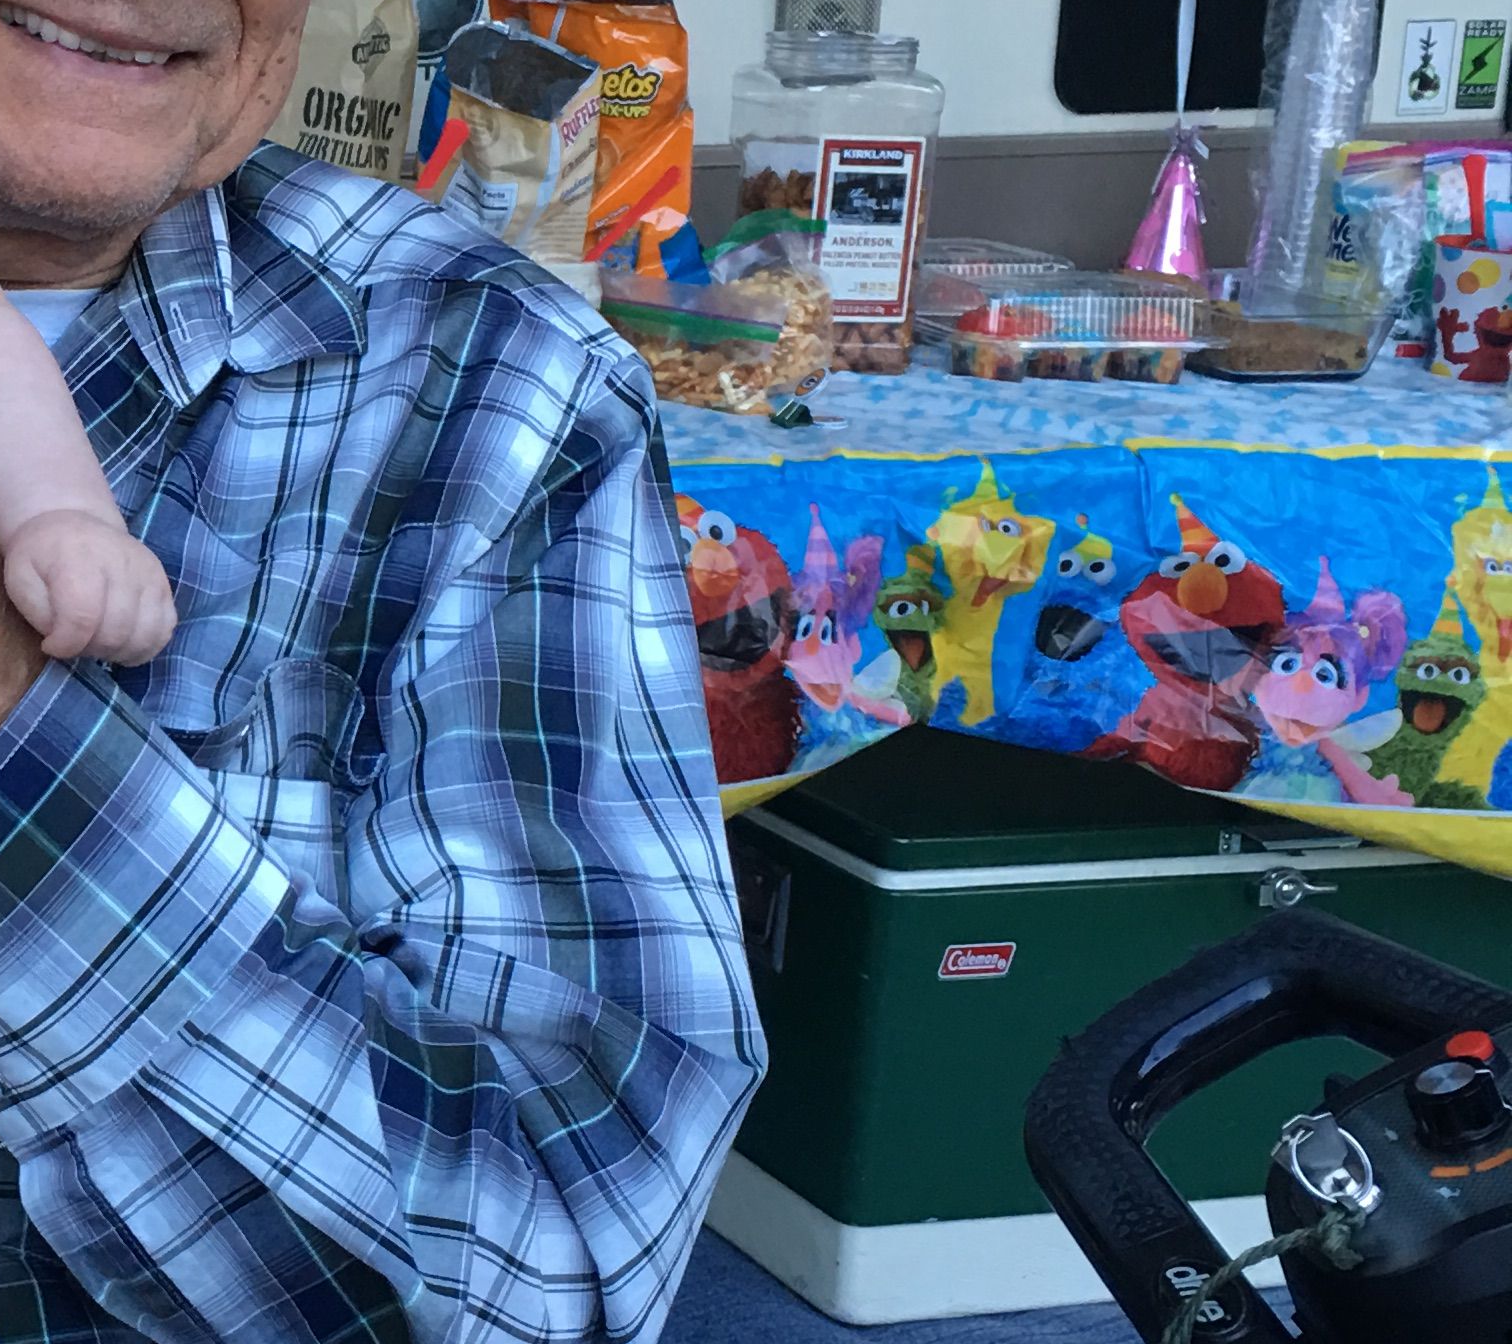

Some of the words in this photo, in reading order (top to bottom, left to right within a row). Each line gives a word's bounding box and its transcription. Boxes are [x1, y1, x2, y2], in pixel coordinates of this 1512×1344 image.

[1467, 21, 1505, 29] SOLAR
[1466, 29, 1504, 37] READY
[602, 67, 658, 98] etos
[1459, 85, 1497, 96] ZAMP
[842, 149, 904, 160] KIRKLAND
[948, 950, 999, 971] Coleman
[1166, 1266, 1225, 1323] drie
